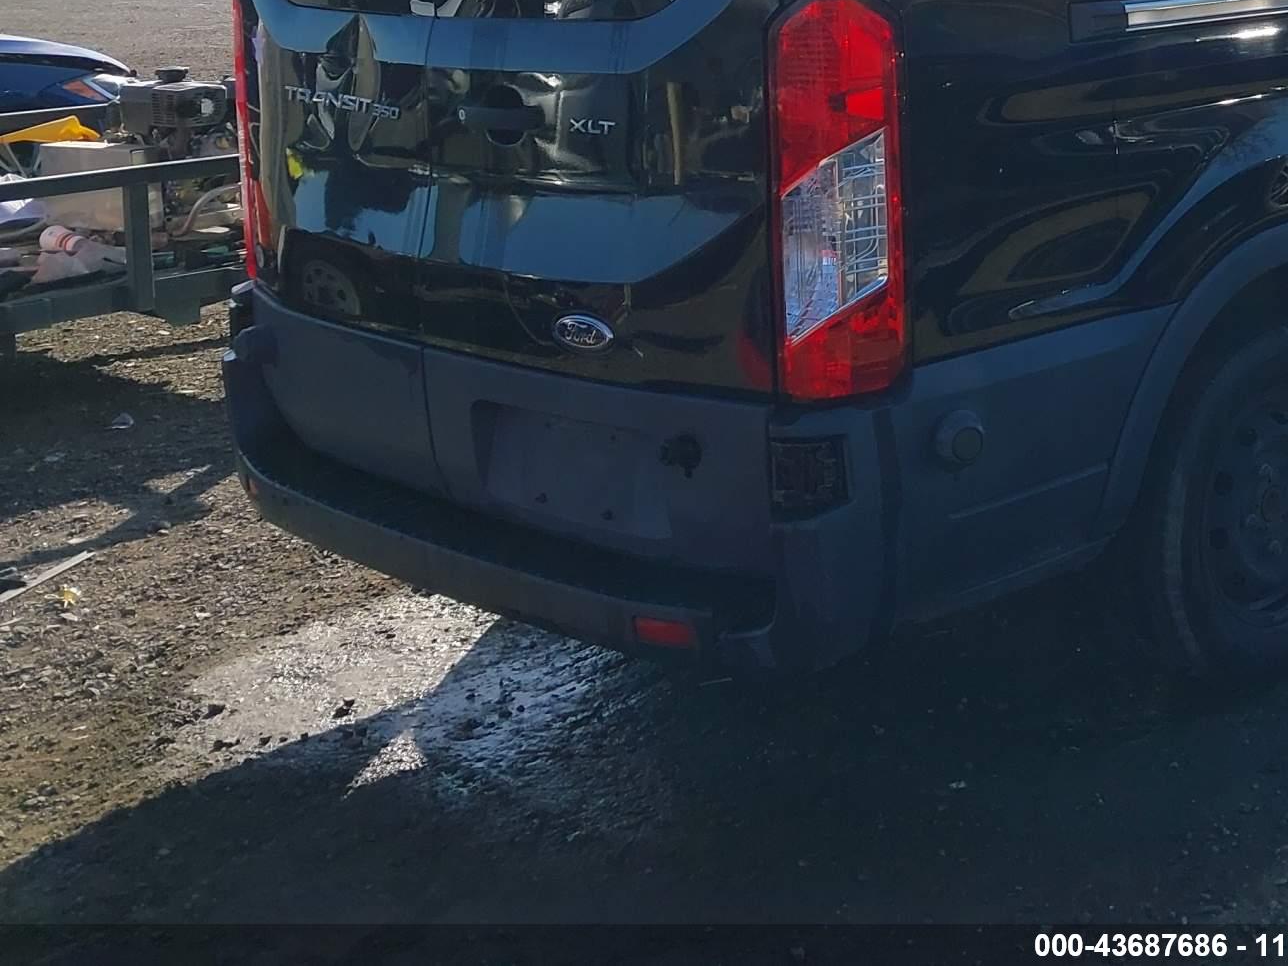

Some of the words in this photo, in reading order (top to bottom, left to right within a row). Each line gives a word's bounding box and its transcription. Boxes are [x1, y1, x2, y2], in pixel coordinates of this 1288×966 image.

[284, 85, 372, 113] TRANSIT
[371, 103, 400, 120] 350
[569, 118, 616, 135] XLT
